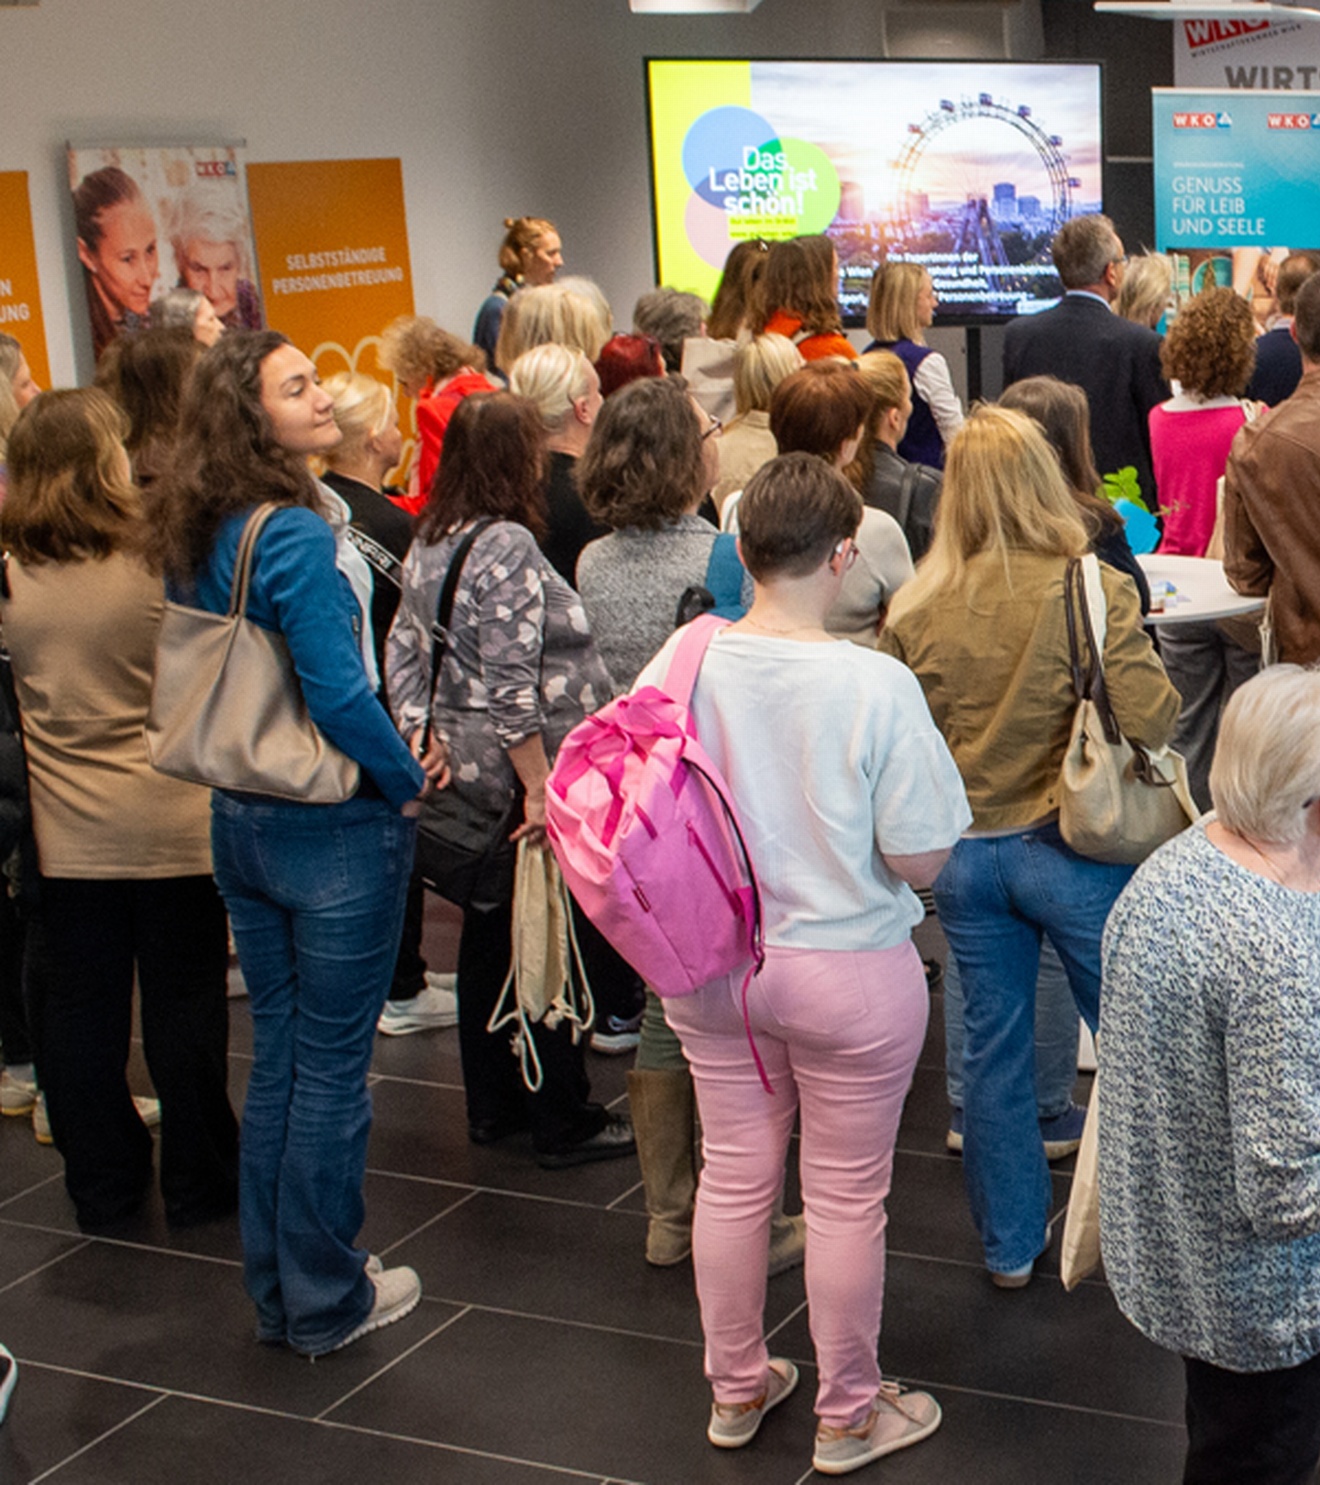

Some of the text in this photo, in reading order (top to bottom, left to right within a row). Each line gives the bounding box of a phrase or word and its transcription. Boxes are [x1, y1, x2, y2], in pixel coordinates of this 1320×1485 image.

[1173, 114, 1214, 128] WKO
[1267, 115, 1311, 128] WKO
[743, 146, 789, 171] Das
[709, 166, 818, 192] Leben ist
[1172, 176, 1243, 195] GENUSS
[723, 189, 804, 215] schön!
[1172, 195, 1245, 215] FÜR LEIB
[1172, 218, 1266, 236] UND SEELE
[285, 246, 387, 271] SELBSTSTÄNDIGE
[272, 266, 404, 295] PERSONENBETREUUNG
